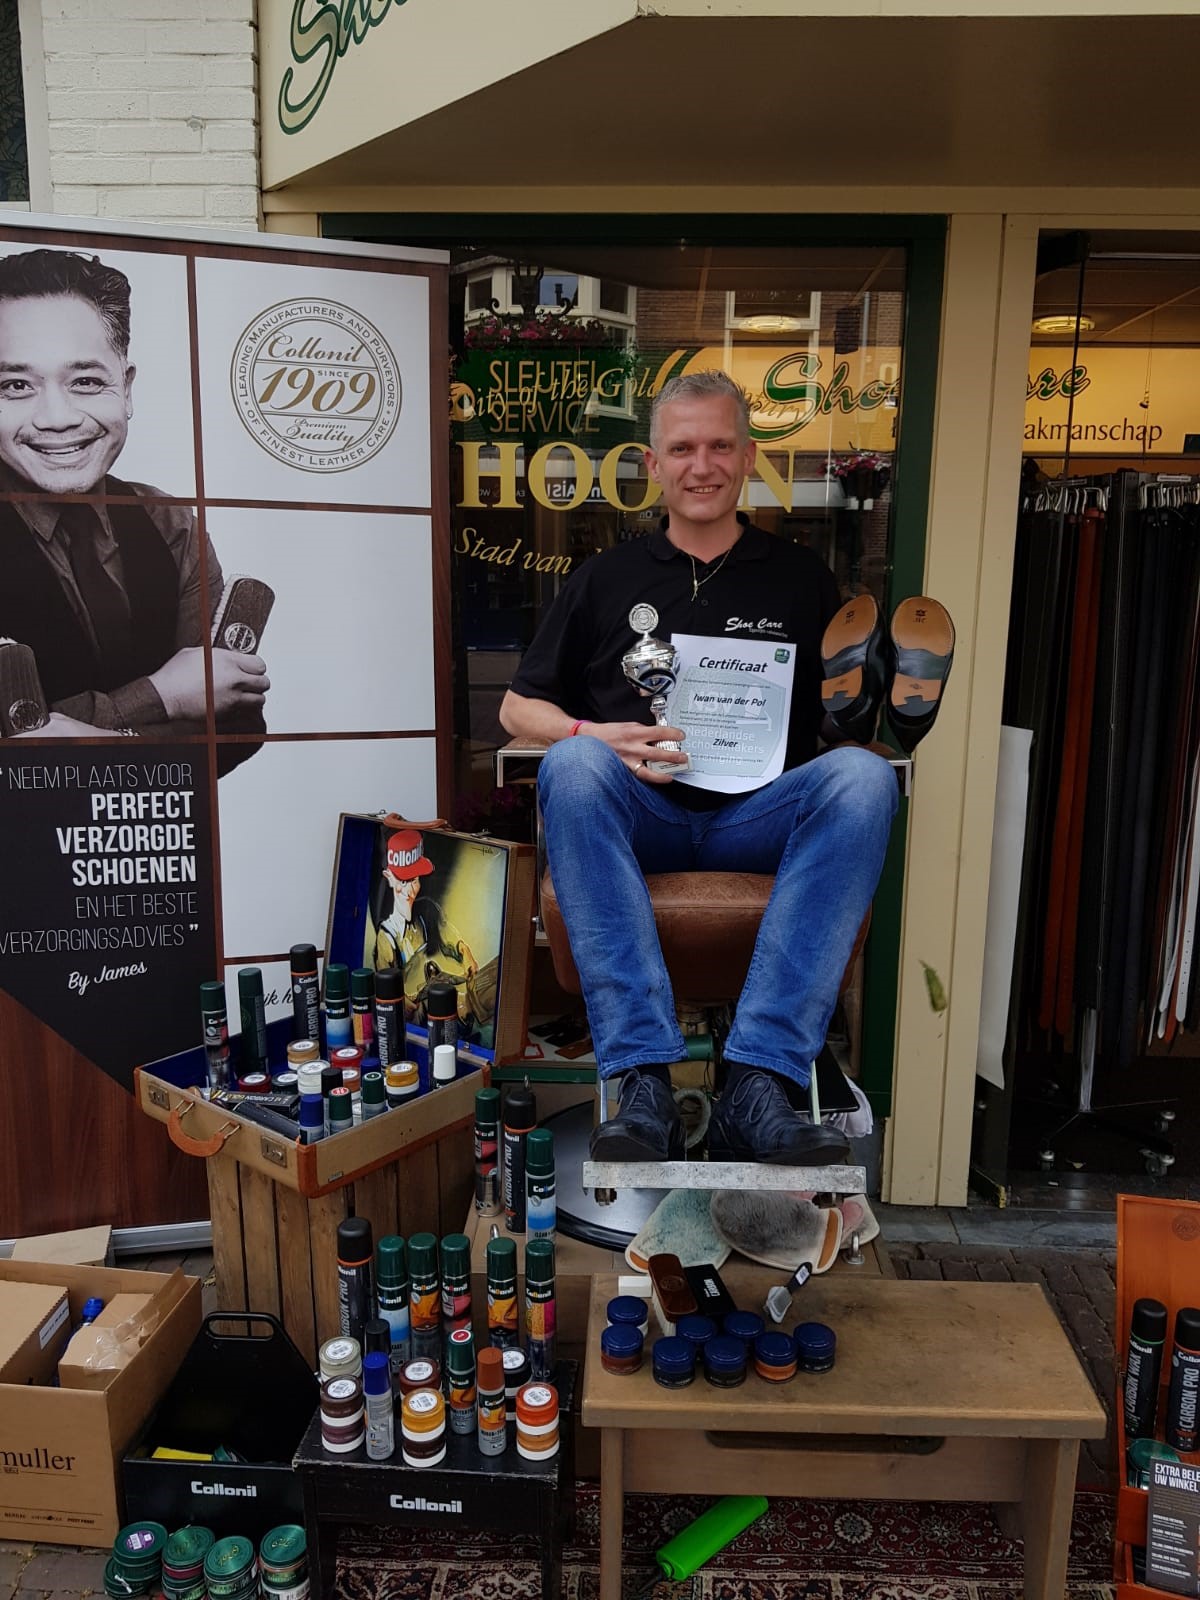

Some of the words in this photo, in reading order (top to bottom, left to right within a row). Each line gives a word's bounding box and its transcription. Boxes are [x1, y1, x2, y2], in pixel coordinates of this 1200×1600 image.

[239, 344, 253, 398] LEADING
[249, 305, 344, 344] MANUFACTURERS
[346, 318, 371, 339] AND
[369, 337, 396, 408] PURVEYORS
[268, 331, 366, 363] Collonil
[317, 369, 350, 378] SINCE
[550, 368, 588, 401] the
[258, 366, 377, 416] 1909
[294, 418, 347, 429] Premium
[489, 400, 601, 433] SERVICE
[246, 409, 262, 426] OF
[260, 428, 305, 462] FINEST
[309, 446, 366, 466] LEATHER
[366, 418, 390, 448] CARE
[282, 424, 357, 452] Quality
[456, 441, 801, 513] HOON
[454, 527, 521, 566] Stad
[523, 551, 573, 575] van
[725, 617, 754, 631] Shoe
[757, 618, 783, 629] Care
[699, 656, 769, 673] Certificaat
[693, 693, 715, 703] Iwan
[734, 697, 750, 705] der
[750, 698, 767, 707] Pol
[713, 738, 738, 748] Zilver
[9, 766, 60, 790] NEEM
[64, 764, 139, 789] PLAATS
[143, 763, 193, 787] VOOR
[91, 791, 194, 821] PERFECT
[56, 823, 196, 854] VERZORGDE
[72, 855, 197, 887] SCHOENEN
[75, 896, 99, 919] EN
[103, 894, 138, 918] HET
[143, 892, 198, 917] BESTE
[68, 971, 90, 996] By
[94, 961, 148, 984] James
[1183, 1367, 1200, 1390] PRO
[1179, 1389, 1199, 1433] CARBON
[1154, 1463, 1181, 1479] EXTRA
[1154, 1474, 1168, 1487] UW
[1168, 1477, 1199, 1494] WINKEL
[191, 1480, 257, 1498] Collonil
[390, 1494, 463, 1514] Collonil
